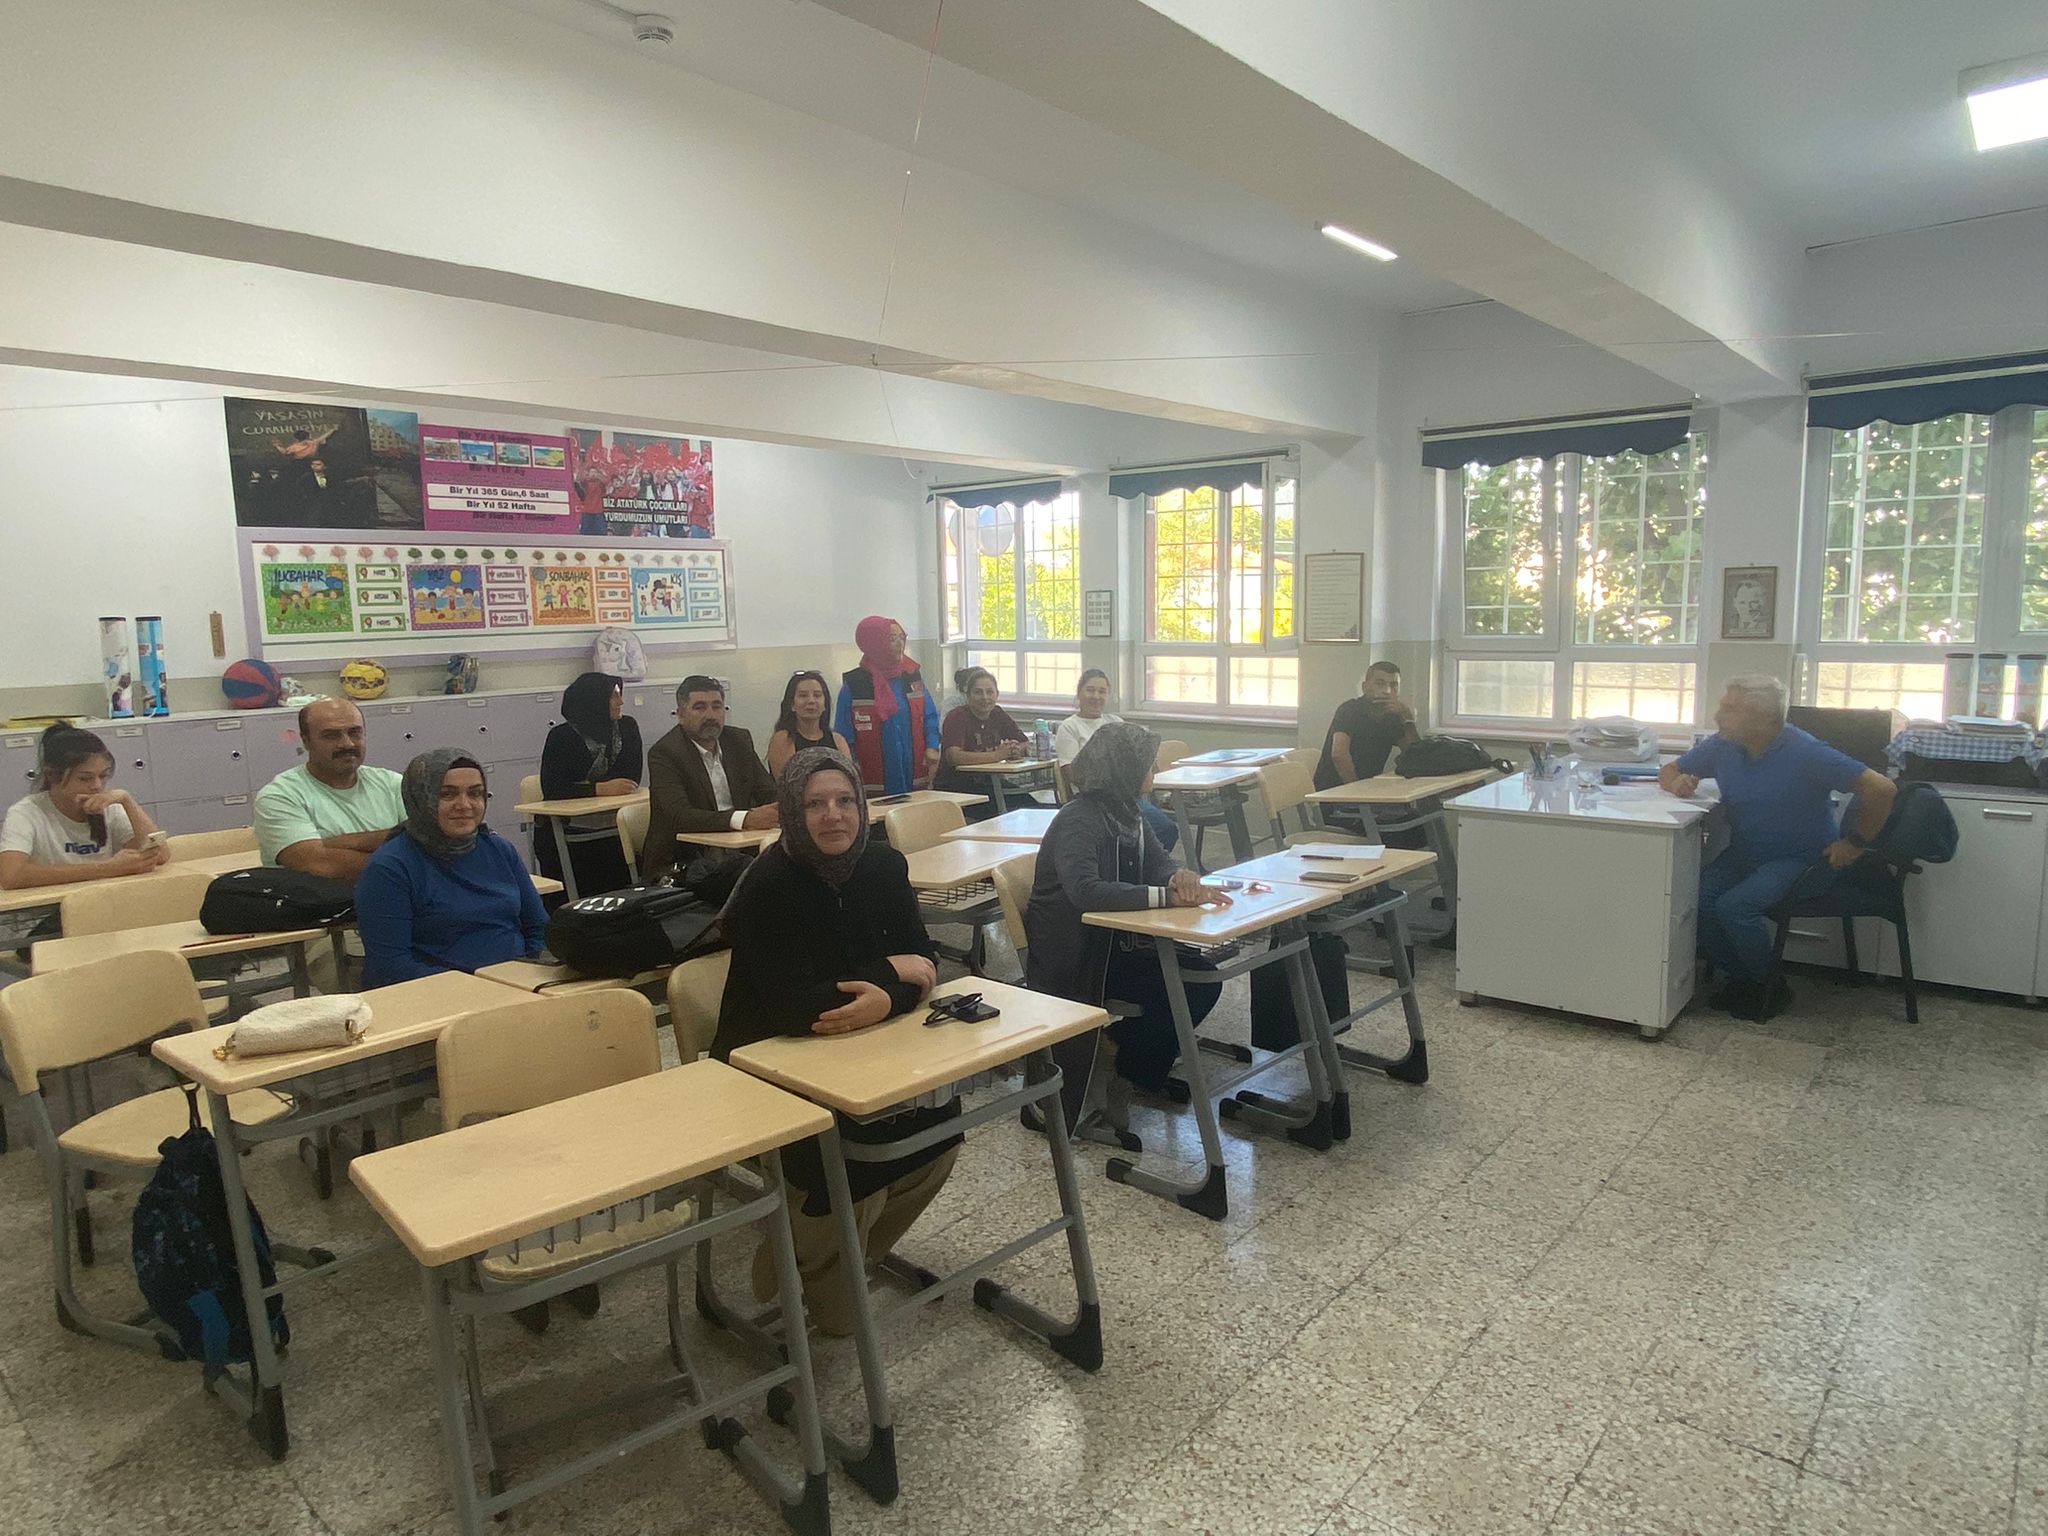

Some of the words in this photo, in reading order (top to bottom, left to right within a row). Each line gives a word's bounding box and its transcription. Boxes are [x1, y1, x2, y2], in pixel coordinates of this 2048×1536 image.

[449, 486, 464, 495] Bir
[465, 487, 479, 496] Yıl
[481, 488, 499, 497] 365
[529, 490, 549, 499] Saat
[466, 500, 480, 509] Bir
[482, 501, 495, 510] Yıl
[497, 502, 509, 510] 52
[511, 502, 536, 511] Hafta
[604, 497, 616, 508] BİZ
[617, 499, 648, 509] ATATÜRK
[649, 499, 688, 512] ÇOCUKLARI
